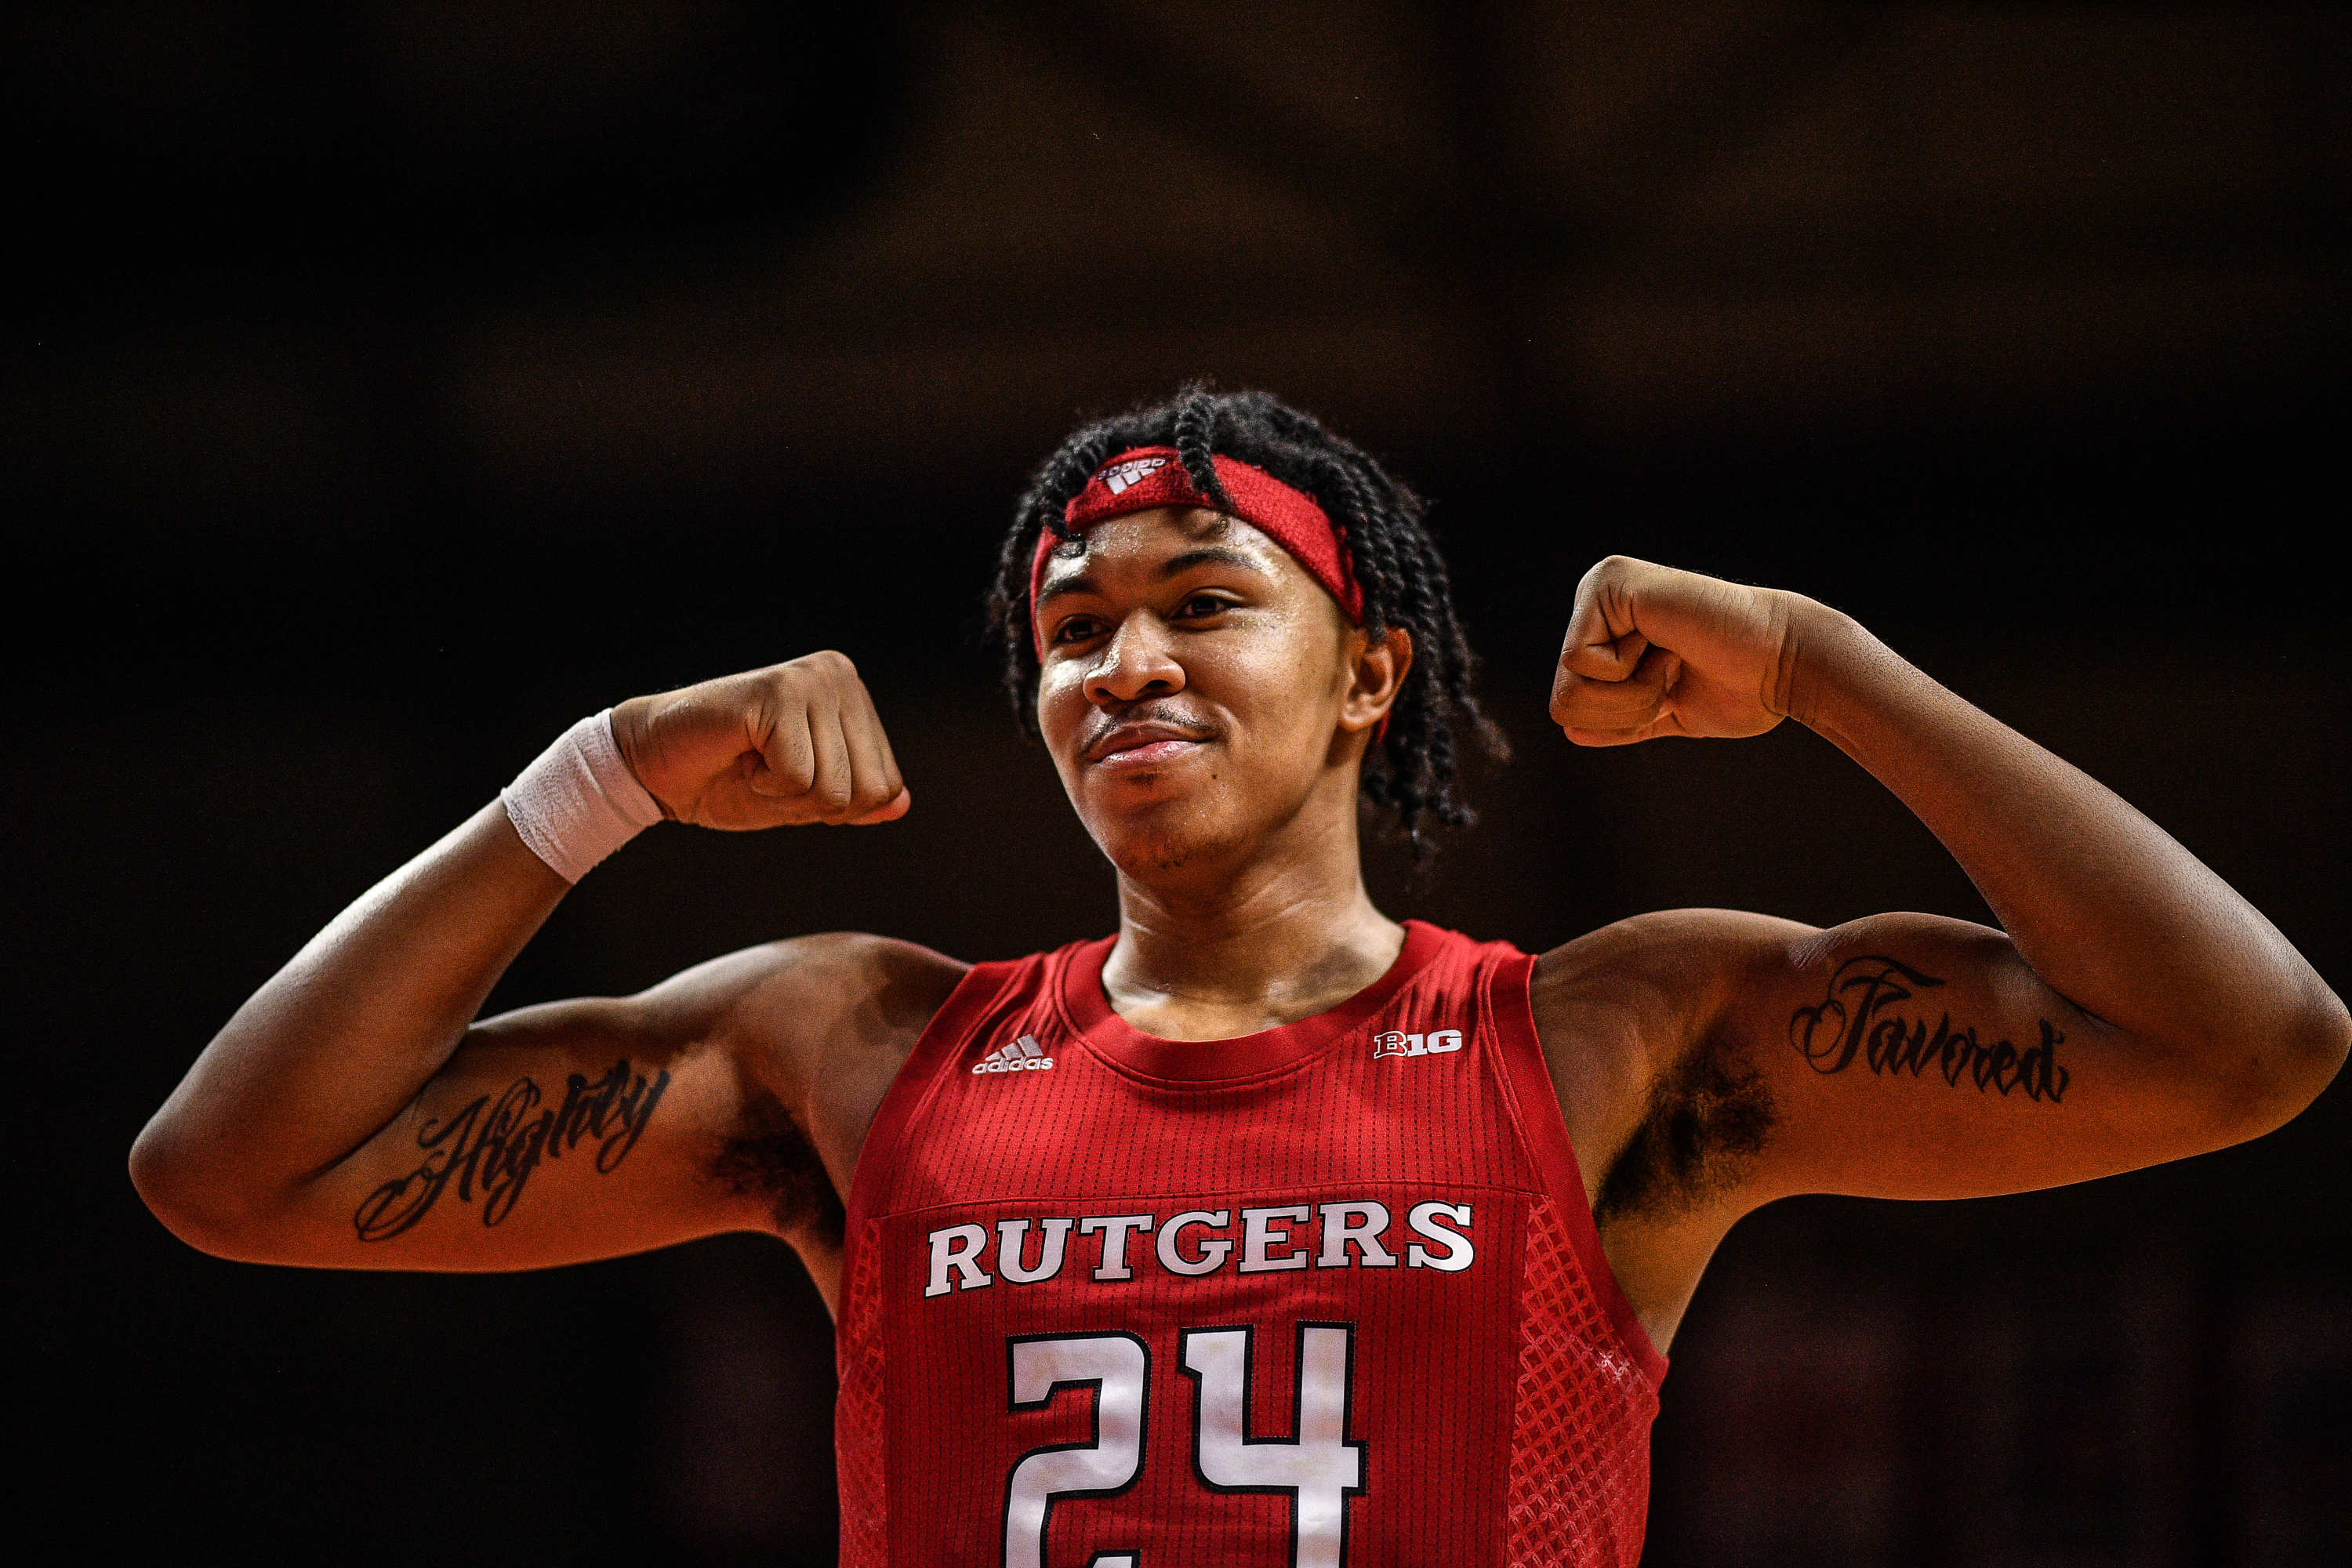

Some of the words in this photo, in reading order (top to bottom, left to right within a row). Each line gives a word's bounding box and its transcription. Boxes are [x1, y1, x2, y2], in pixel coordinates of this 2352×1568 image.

[972, 1057, 1054, 1074] adidas
[1790, 955, 2071, 1103] Favored
[924, 1200, 1475, 1298] RUTGERS
[1005, 1319, 1367, 1568] 24
